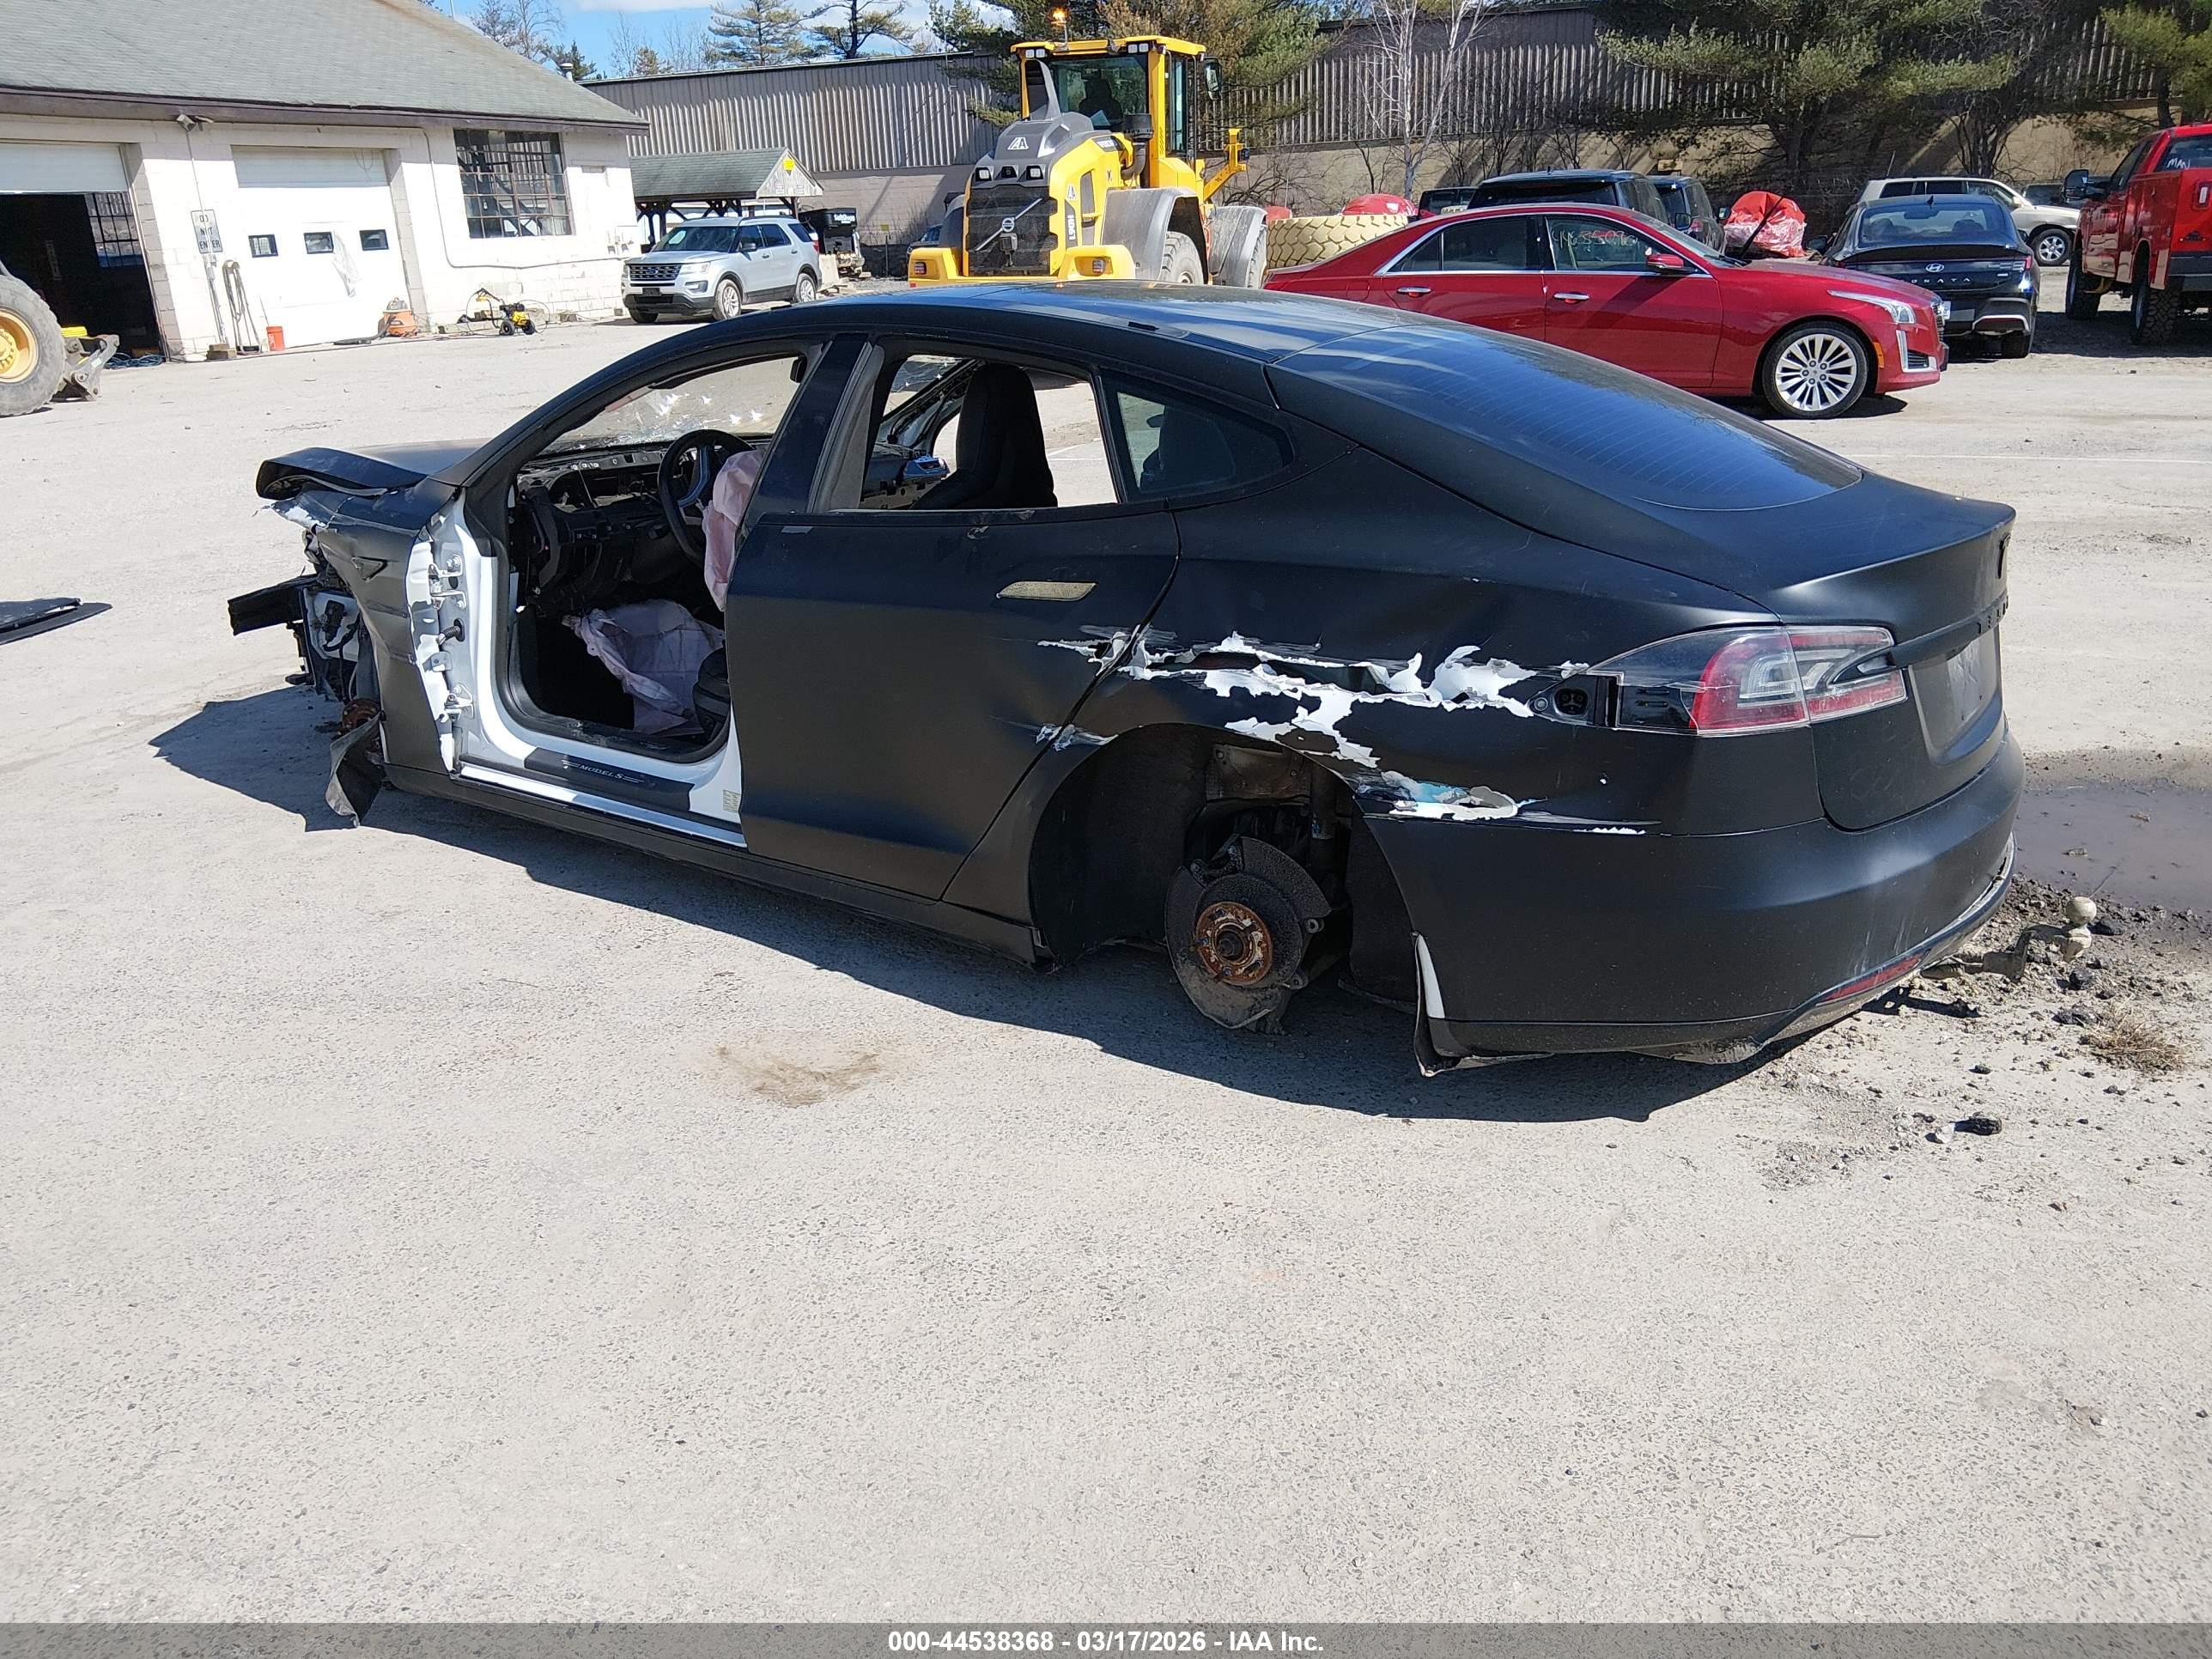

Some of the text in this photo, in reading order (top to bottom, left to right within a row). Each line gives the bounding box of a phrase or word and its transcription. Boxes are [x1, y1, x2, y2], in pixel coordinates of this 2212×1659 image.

[200, 227, 212, 235] NT
[199, 240, 221, 249] ENER
[579, 764, 614, 777] MODEL
